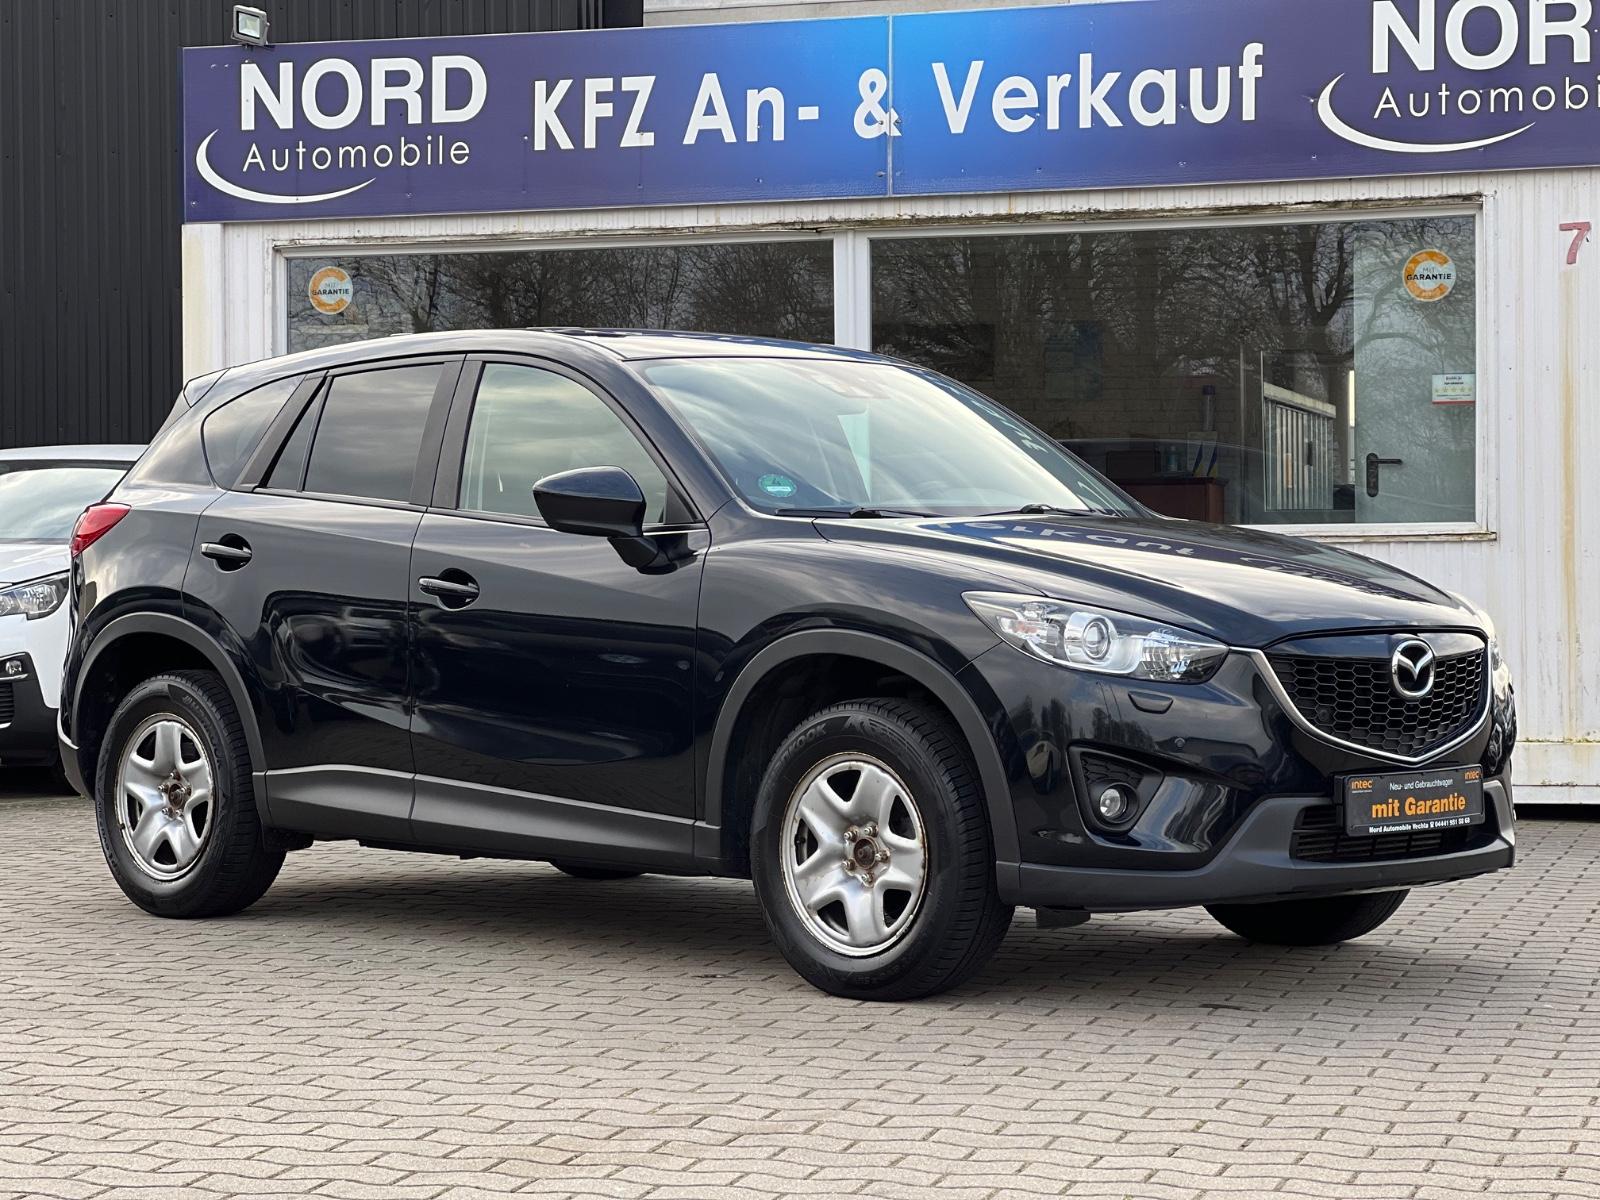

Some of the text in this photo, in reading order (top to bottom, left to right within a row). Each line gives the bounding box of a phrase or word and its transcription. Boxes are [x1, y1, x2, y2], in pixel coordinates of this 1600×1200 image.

[1372, 0, 1593, 74] NOR
[240, 54, 488, 131] NORD
[533, 42, 1264, 151] KFZ An- & Verkauf
[1373, 75, 1600, 119] Automobi
[242, 135, 470, 172] Automobile
[1559, 221, 1592, 265] 7
[1372, 793, 1466, 818] mit Garantie
[1404, 782, 1414, 790] und
[1383, 824, 1411, 832] Automobile
